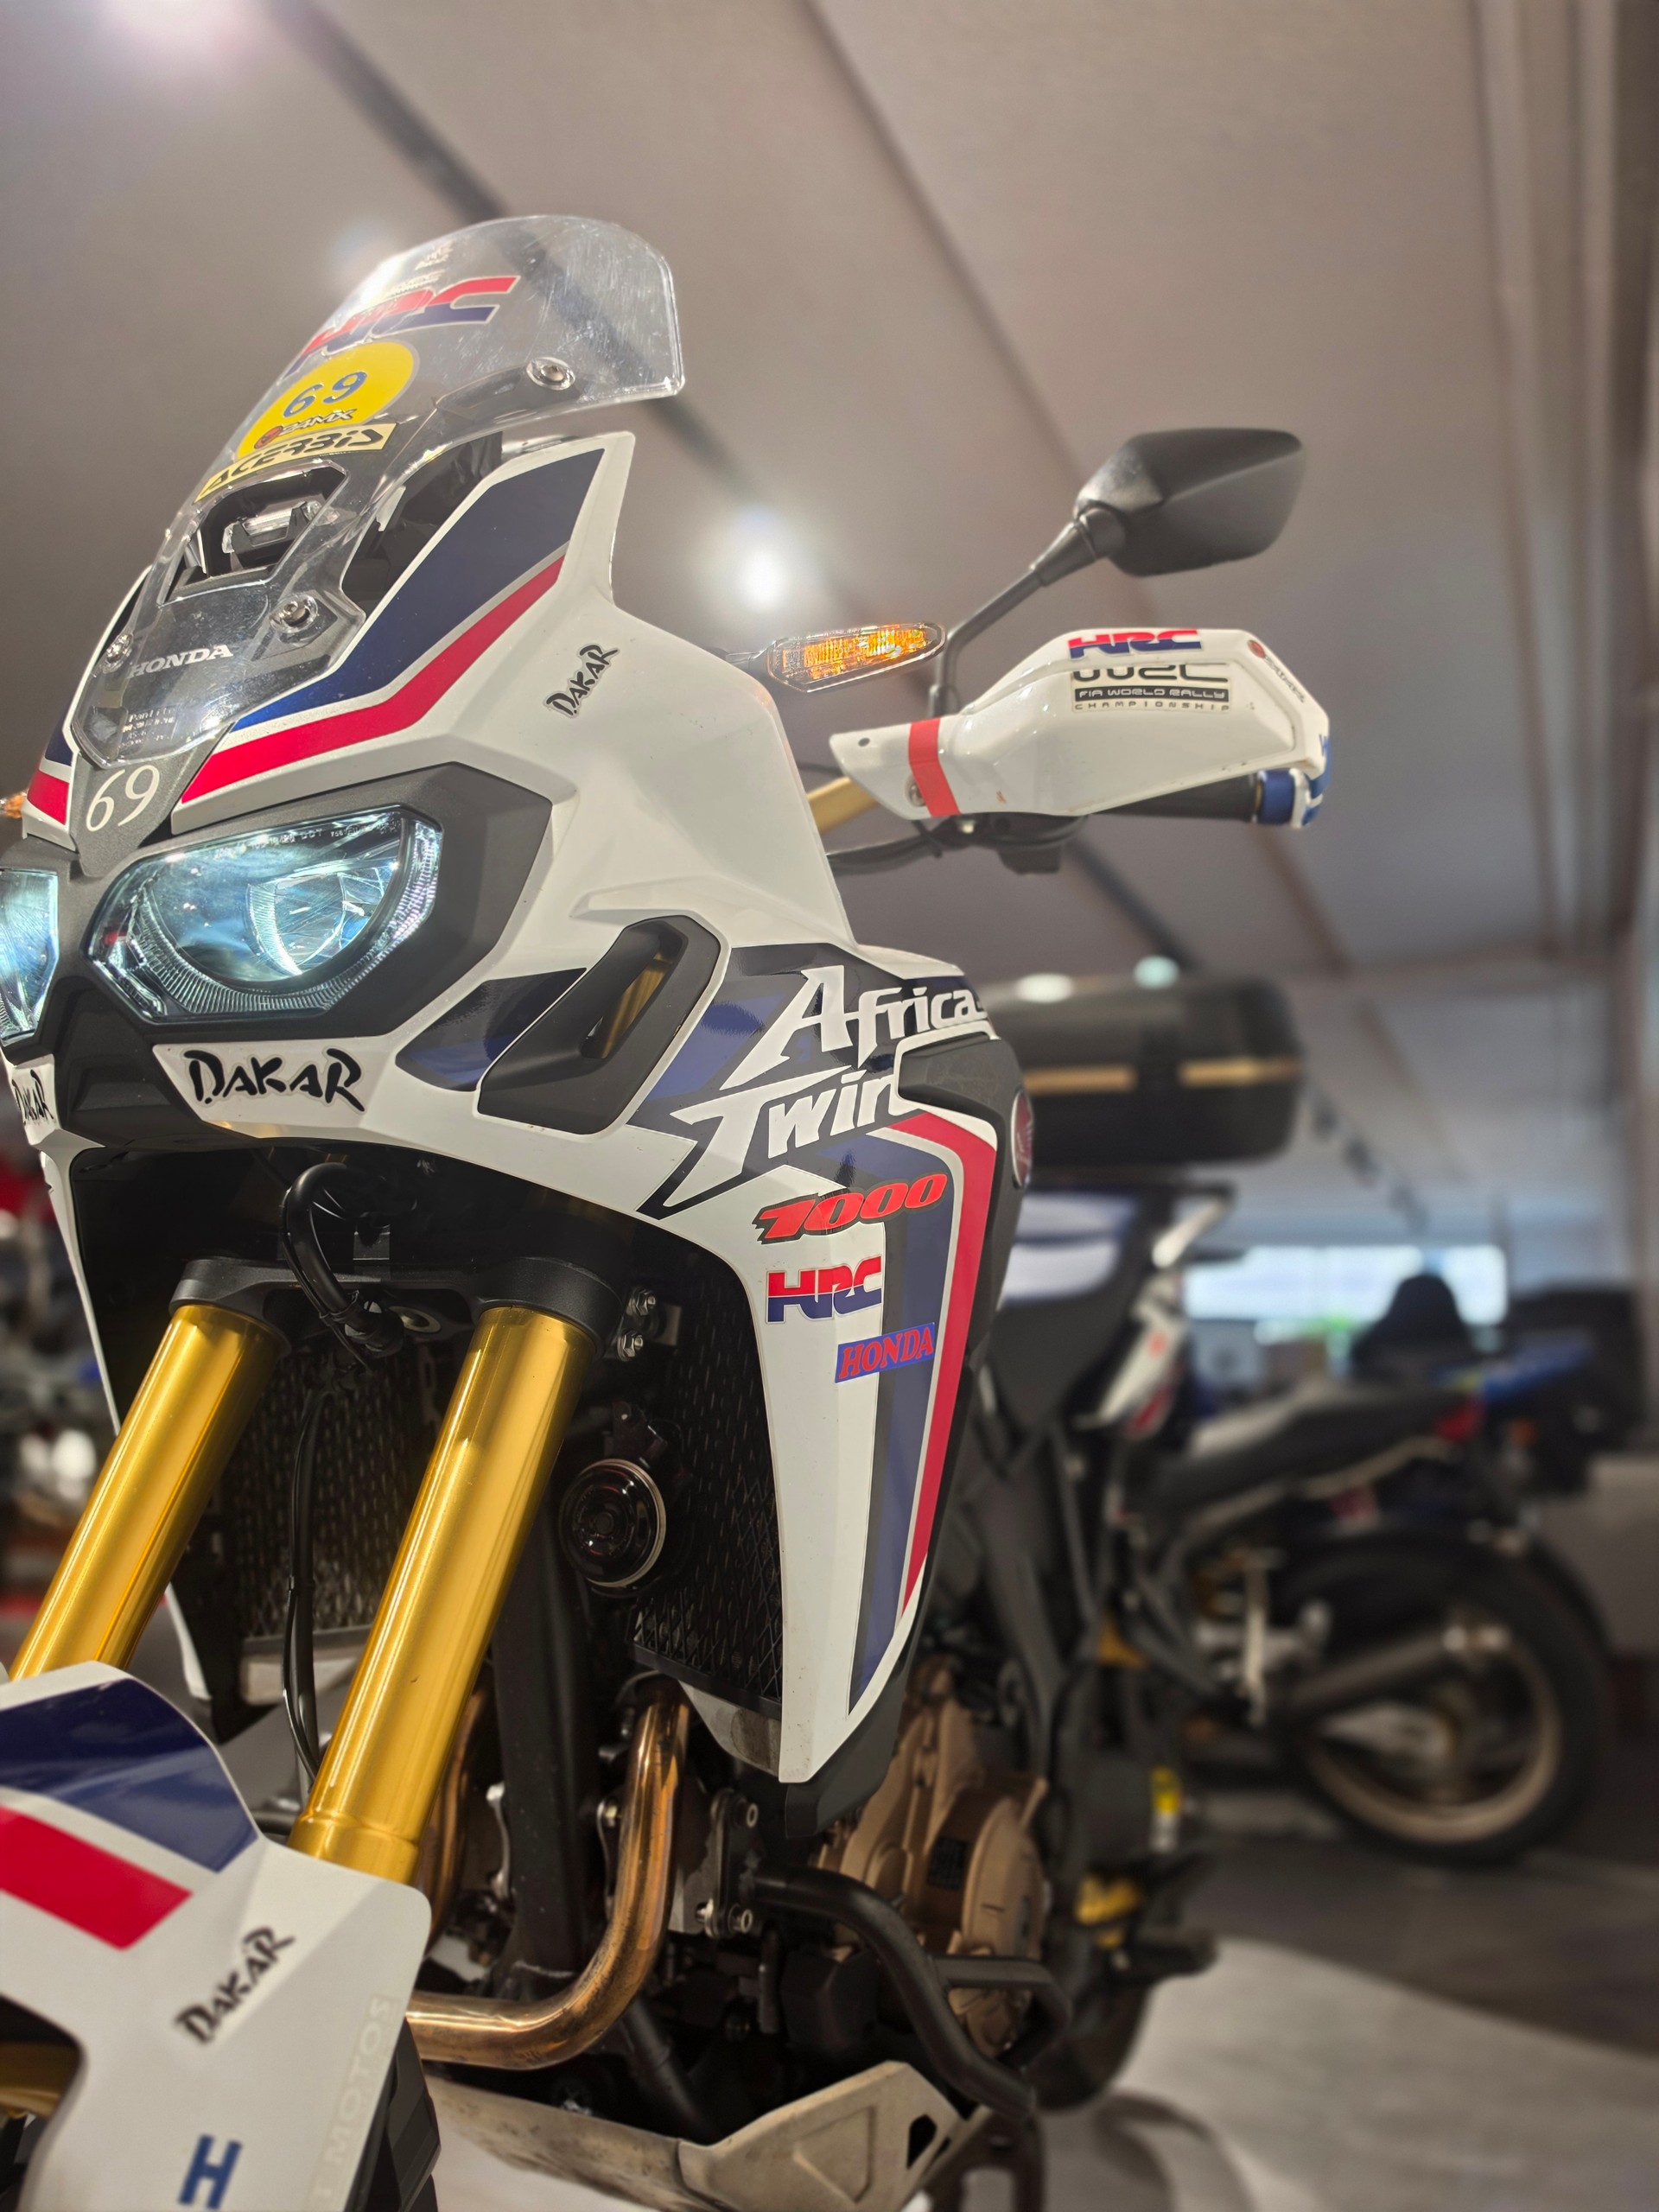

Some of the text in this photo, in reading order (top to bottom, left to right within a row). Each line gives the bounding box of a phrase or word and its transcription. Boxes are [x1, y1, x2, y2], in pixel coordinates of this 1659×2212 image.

[283, 371, 367, 418] 69
[194, 429, 384, 503] ACERBIS
[127, 644, 233, 679] HONDA
[1067, 628, 1202, 659] HRC
[546, 644, 619, 716] DAKAR
[1075, 701, 1230, 711] CHAMPIONSHIP
[1107, 689, 1166, 697] WORLD
[1169, 689, 1225, 699] RALLY
[86, 765, 159, 832] 69
[720, 964, 989, 1090] Africa
[184, 1048, 365, 1112] DAKAR
[760, 1173, 948, 1240] 1000
[766, 1255, 882, 1323] HRC
[838, 1326, 935, 1381] HONDA
[175, 1926, 296, 2045] DAKAR
